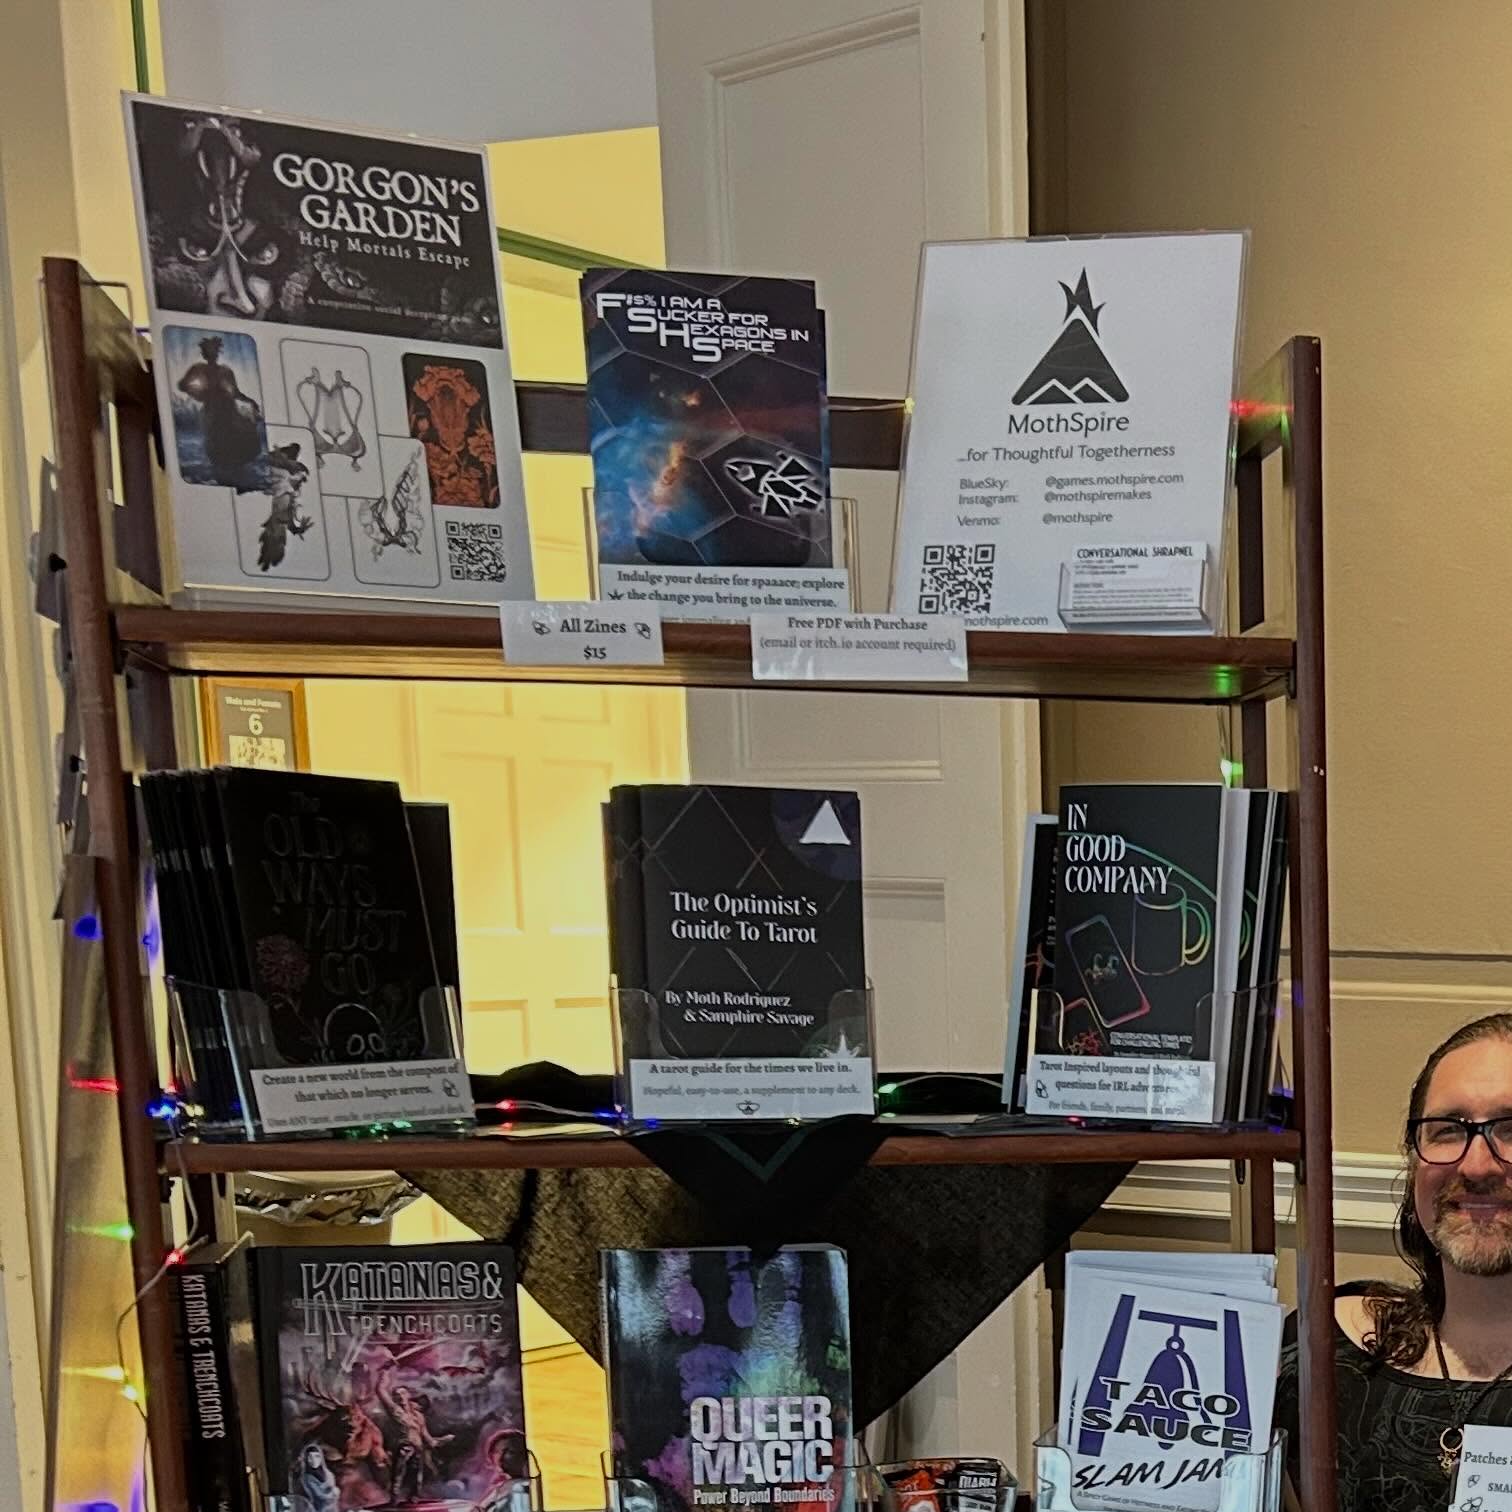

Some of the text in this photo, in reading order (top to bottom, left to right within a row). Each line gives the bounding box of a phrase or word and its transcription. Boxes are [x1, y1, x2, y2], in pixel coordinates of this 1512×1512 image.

[273, 153, 480, 212] GORGON'S
[300, 194, 462, 247] GARDEN
[300, 231, 470, 270] Help Mortals Escape
[669, 296, 703, 309] AM
[706, 298, 721, 311] A
[627, 307, 768, 333] SUCKER FOR
[659, 321, 809, 349] HEXAGONS IN
[692, 337, 775, 363] SPACE
[1007, 411, 1131, 438] MothSpire
[993, 445, 1074, 463] Thoughtful
[1077, 444, 1176, 464] Togetherness
[960, 472, 1184, 491] BlueSky: @games.mothspire.com
[958, 489, 1152, 507] Instagram: @mothspiremakes
[957, 511, 1114, 527] Venmo: @mothspire
[1076, 547, 1149, 560] CONVERSATIONAL
[617, 570, 662, 585] Indulge
[665, 575, 692, 589] your
[695, 573, 730, 586] desire
[732, 574, 750, 586] for
[802, 577, 845, 592] explore
[627, 589, 837, 608] the change you bring to the universe.
[560, 618, 627, 634] All Zines
[787, 616, 928, 631] Free PDF with Purchase
[583, 644, 607, 660] $15
[248, 713, 263, 735] 6
[1067, 803, 1088, 831] IN
[1065, 834, 1126, 862] GOOD
[1064, 866, 1173, 895] COMPANY
[669, 891, 818, 917] The Optimist's
[671, 919, 819, 943] Guide To Tarot
[664, 990, 792, 1008] By Moth Rodriguez
[684, 1008, 816, 1027] & Samphire Savage
[181, 1274, 212, 1334] KATANAS
[348, 1313, 503, 1336] TRENCHCOATS
[192, 1350, 227, 1439] TRENCHCOATS
[1098, 1375, 1240, 1417] TACO
[690, 1395, 834, 1451] QUEER
[1081, 1407, 1253, 1453] SAUCE
[692, 1441, 835, 1486] MAGIC
[1463, 1451, 1508, 1467] Patches
[1071, 1459, 1164, 1490] SLAM
[694, 1486, 836, 1507] Power Beyond Boundaries
